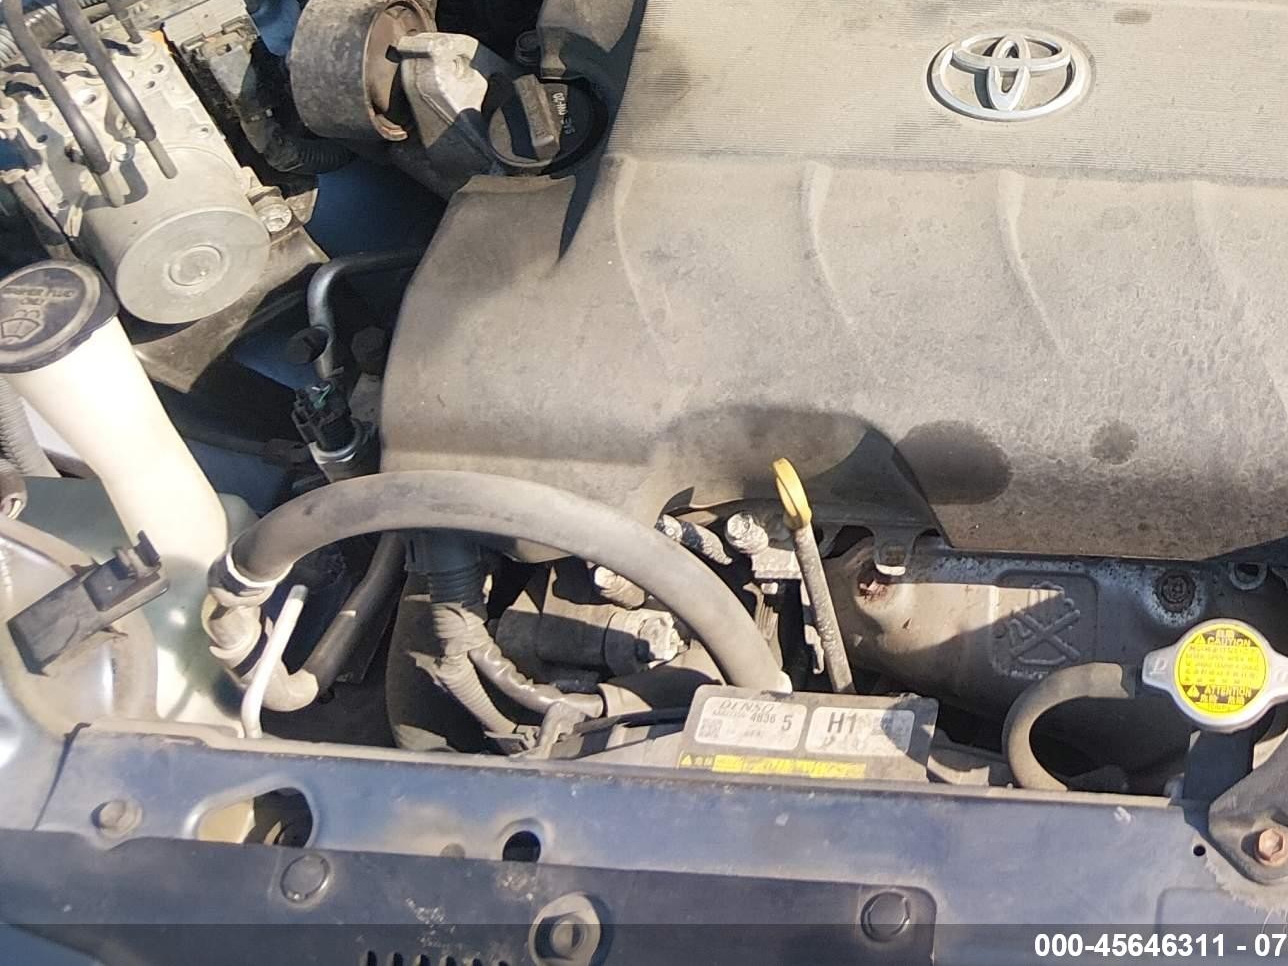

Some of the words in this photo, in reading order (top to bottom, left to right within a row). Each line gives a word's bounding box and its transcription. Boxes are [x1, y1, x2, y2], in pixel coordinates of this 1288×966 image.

[1207, 636, 1251, 647] CAUTION
[1204, 685, 1252, 699] ATTENTION
[719, 699, 774, 713] DENSO
[781, 715, 793, 731] 5
[827, 711, 858, 734] H1
